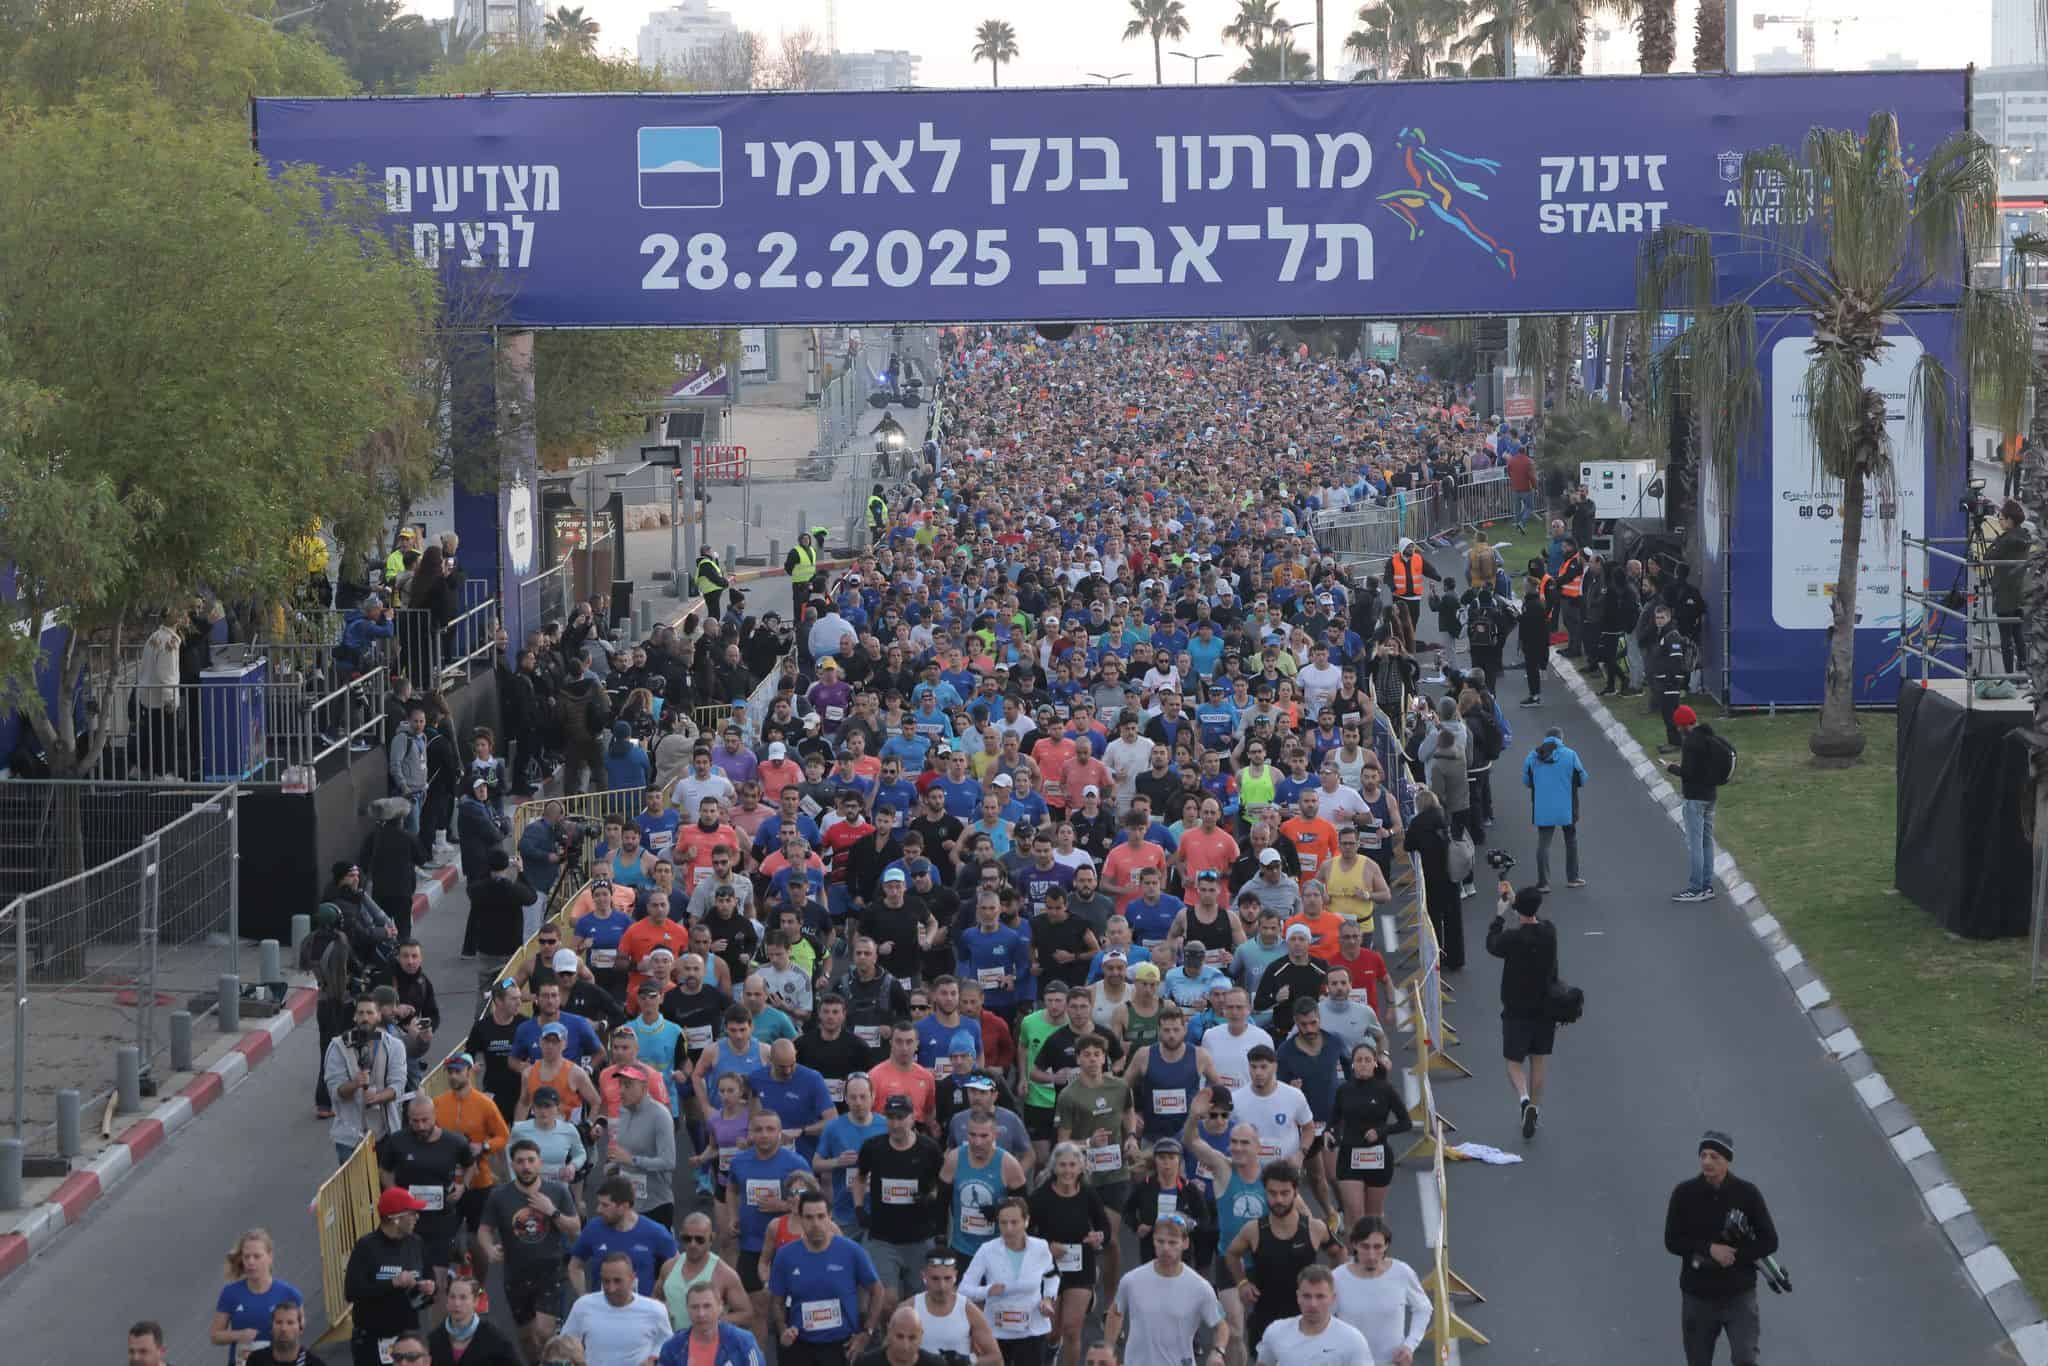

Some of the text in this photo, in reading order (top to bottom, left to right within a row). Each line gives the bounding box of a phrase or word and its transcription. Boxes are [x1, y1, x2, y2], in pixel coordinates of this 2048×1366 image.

[385, 165, 560, 212] מצדיעים
[744, 122, 1373, 205] מרתון בנק לאומי
[1541, 155, 1667, 201] זינוק
[413, 214, 535, 268] לרצים
[1540, 202, 1668, 233] START
[640, 228, 1011, 290] 28.2.2025
